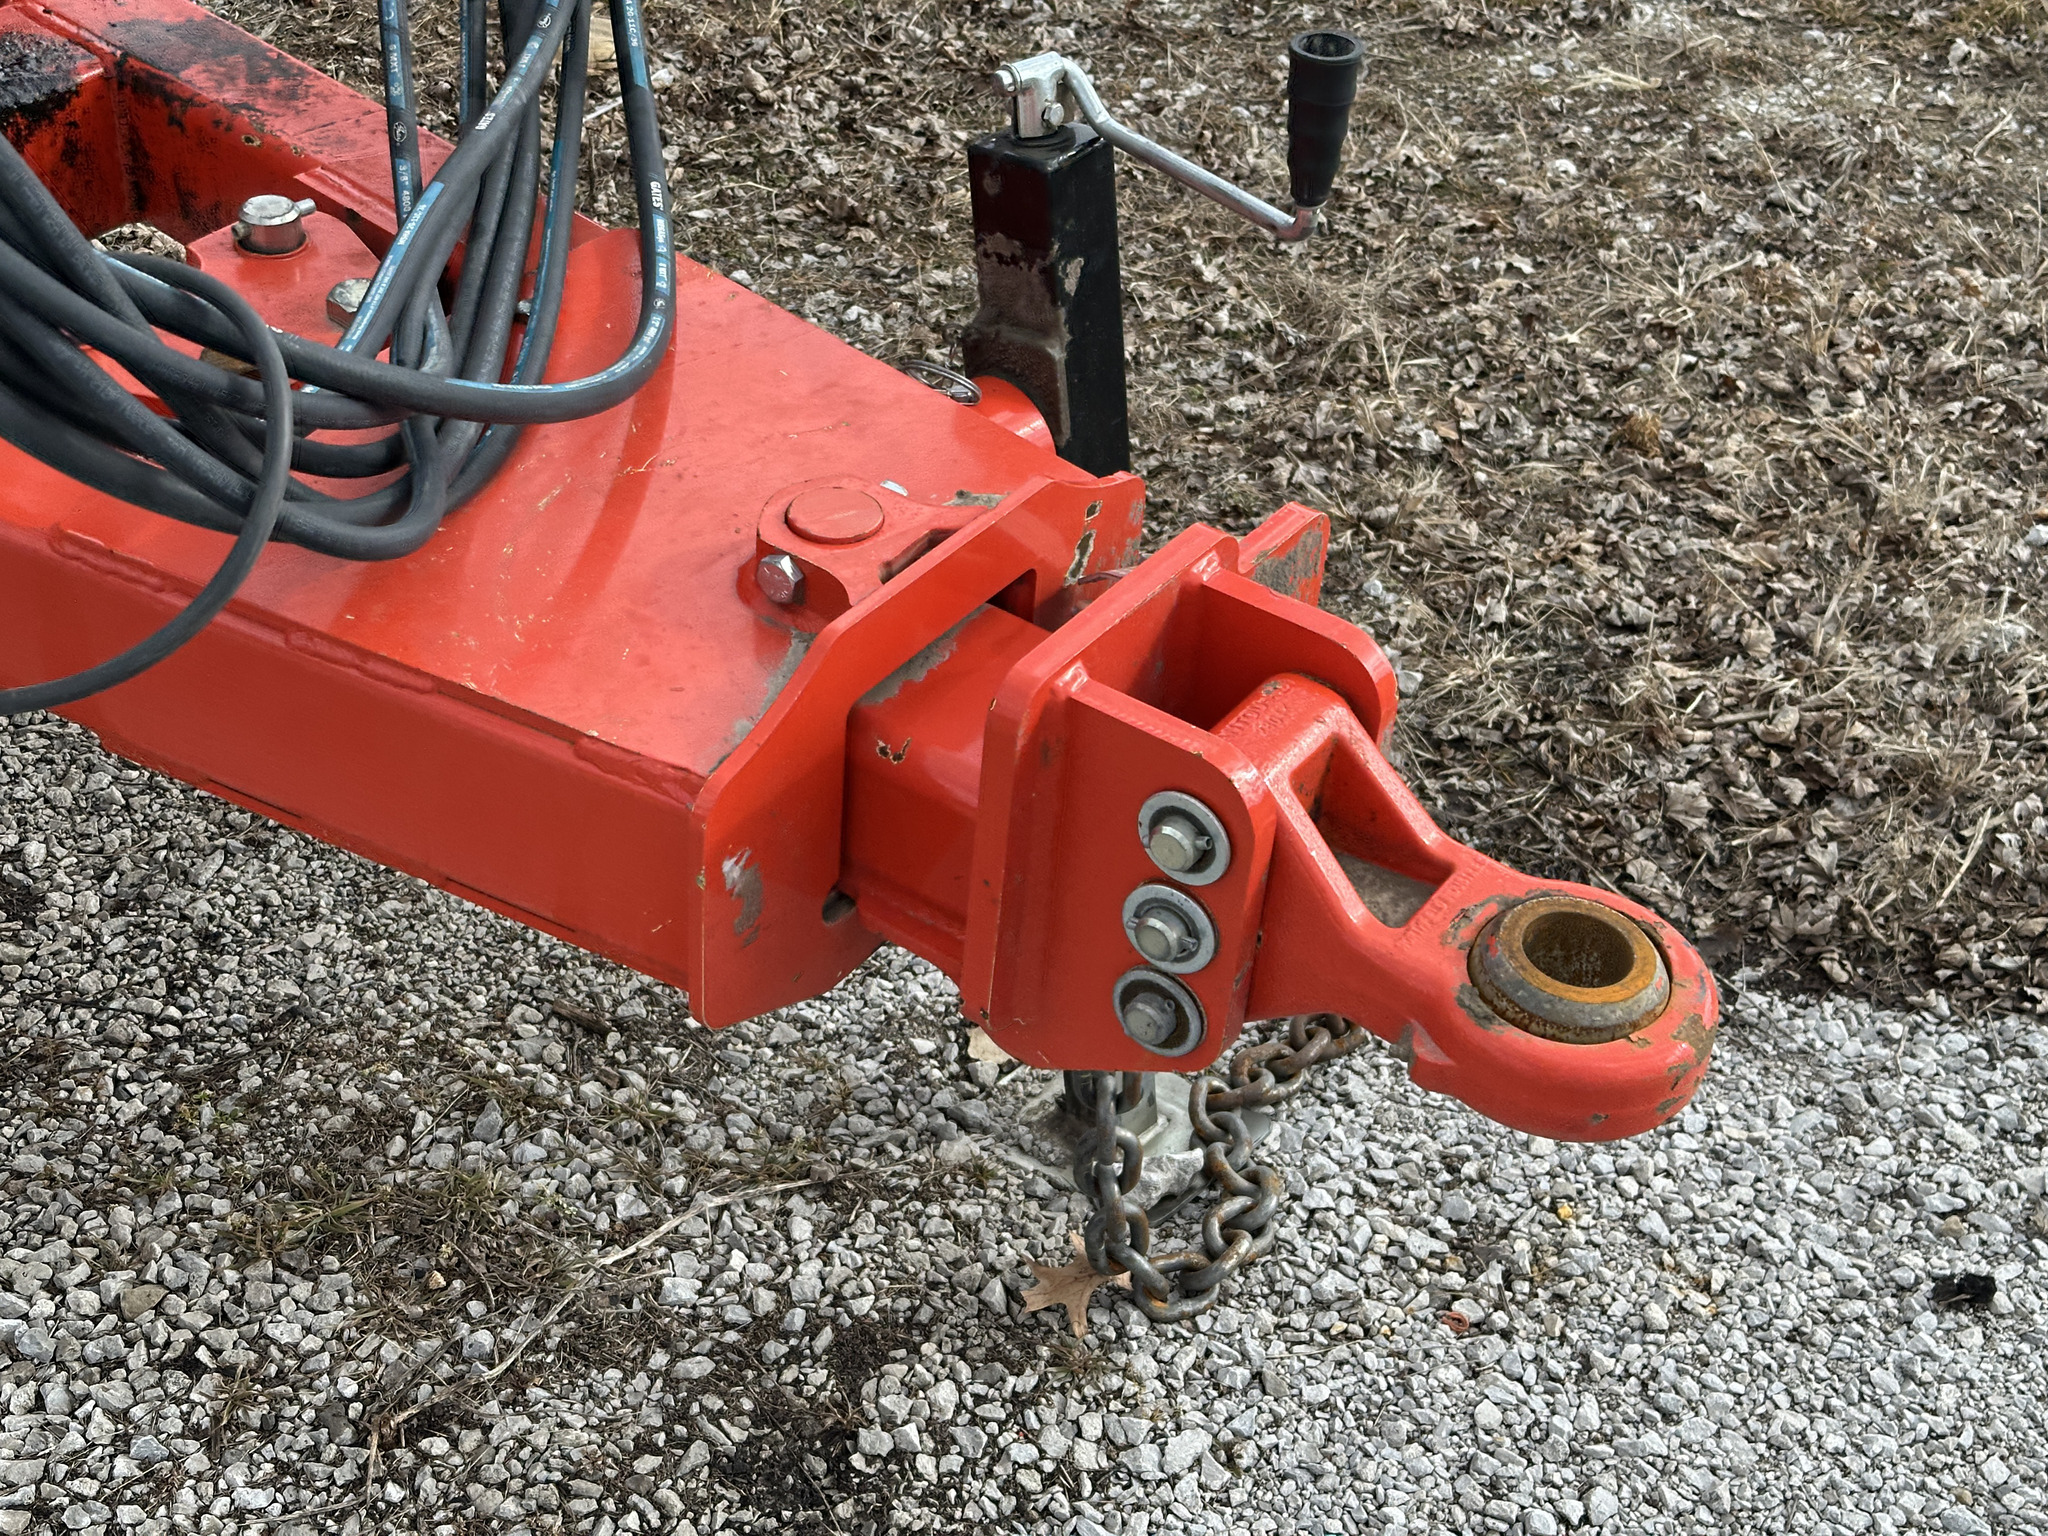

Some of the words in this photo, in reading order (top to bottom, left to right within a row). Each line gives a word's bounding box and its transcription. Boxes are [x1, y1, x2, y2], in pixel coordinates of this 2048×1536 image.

[390, 52, 399, 73] MXT
[475, 112, 496, 130] GATES
[402, 190, 412, 212] 4800
[650, 181, 662, 208] GATES
